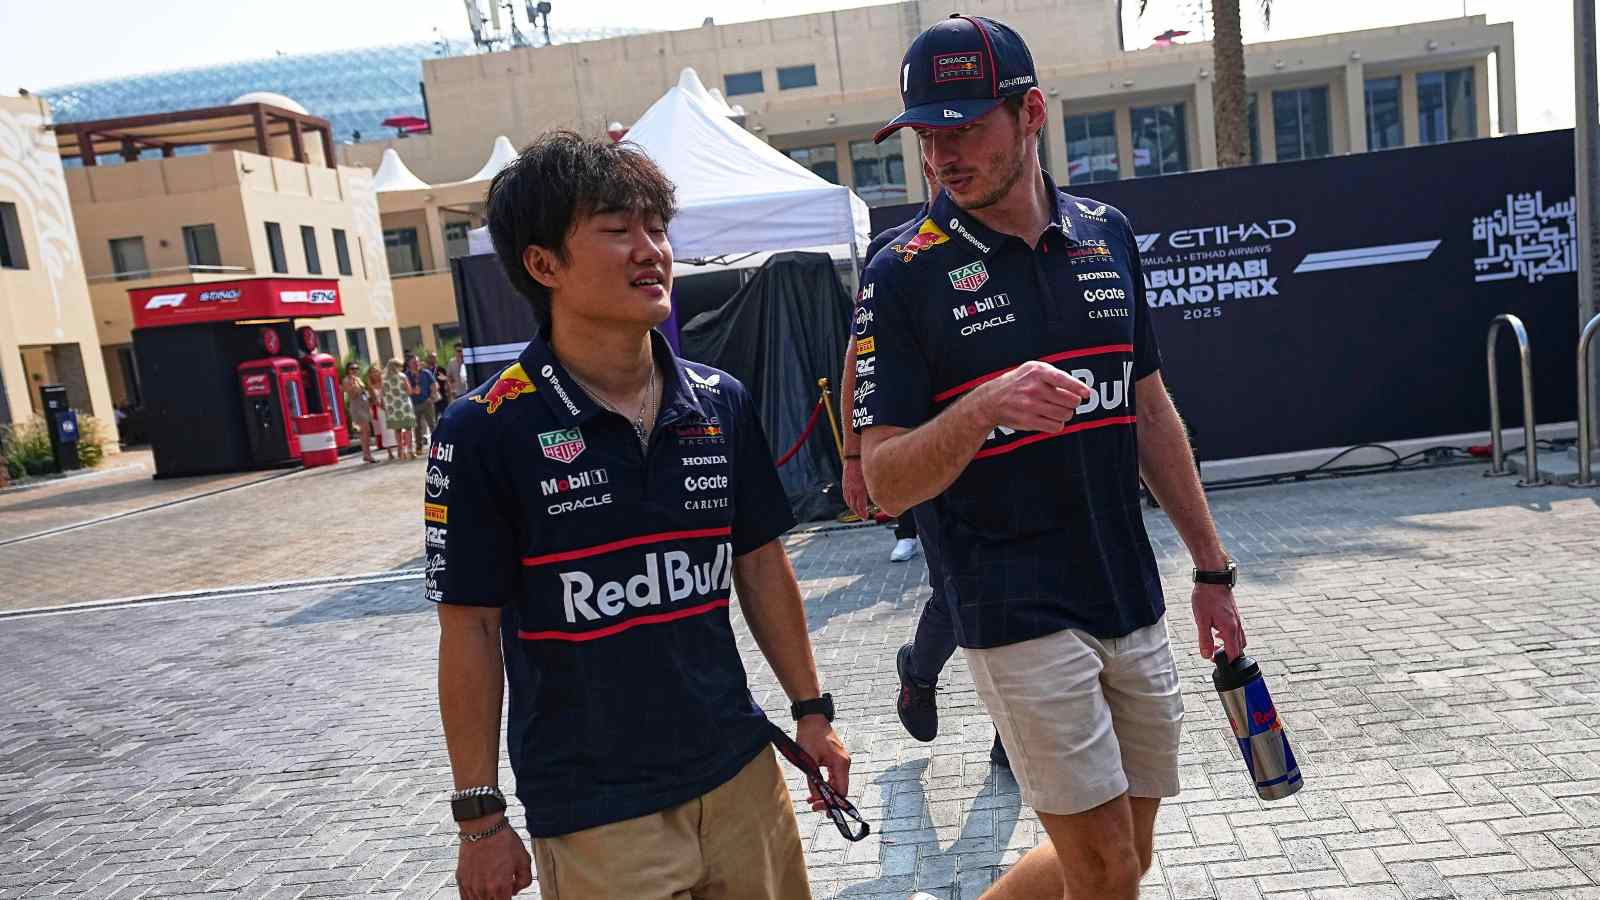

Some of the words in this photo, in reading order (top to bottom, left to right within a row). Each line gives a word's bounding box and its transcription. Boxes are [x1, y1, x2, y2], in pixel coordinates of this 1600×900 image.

[957, 225, 991, 254] 1Password
[1169, 219, 1297, 249] ETIHAD
[1190, 250, 1226, 262] ETIHAD
[1228, 245, 1272, 257] AIRWAYS
[952, 263, 982, 279] TAG
[1077, 271, 1120, 281] HONDA
[1189, 258, 1268, 285] DHABI
[954, 272, 987, 290] HEUER
[857, 282, 875, 300] obil
[1095, 287, 1125, 300] Gate
[1146, 284, 1214, 308] RAND
[1218, 277, 1280, 301] PRIX
[953, 297, 995, 320] Mobil
[1088, 308, 1128, 319] CARLYLE
[1183, 307, 1222, 320] 2025
[960, 313, 1016, 336] ORACLE
[550, 375, 582, 417] 1Password
[853, 415, 874, 428] RADE
[543, 429, 579, 445] TAG
[430, 441, 454, 463] obil
[544, 442, 582, 461] HEUER
[681, 455, 728, 466] HONDA
[541, 471, 591, 496] Mobil
[697, 474, 728, 490] Gate
[547, 493, 613, 515] ORACLE
[684, 497, 728, 510] CARLYLE
